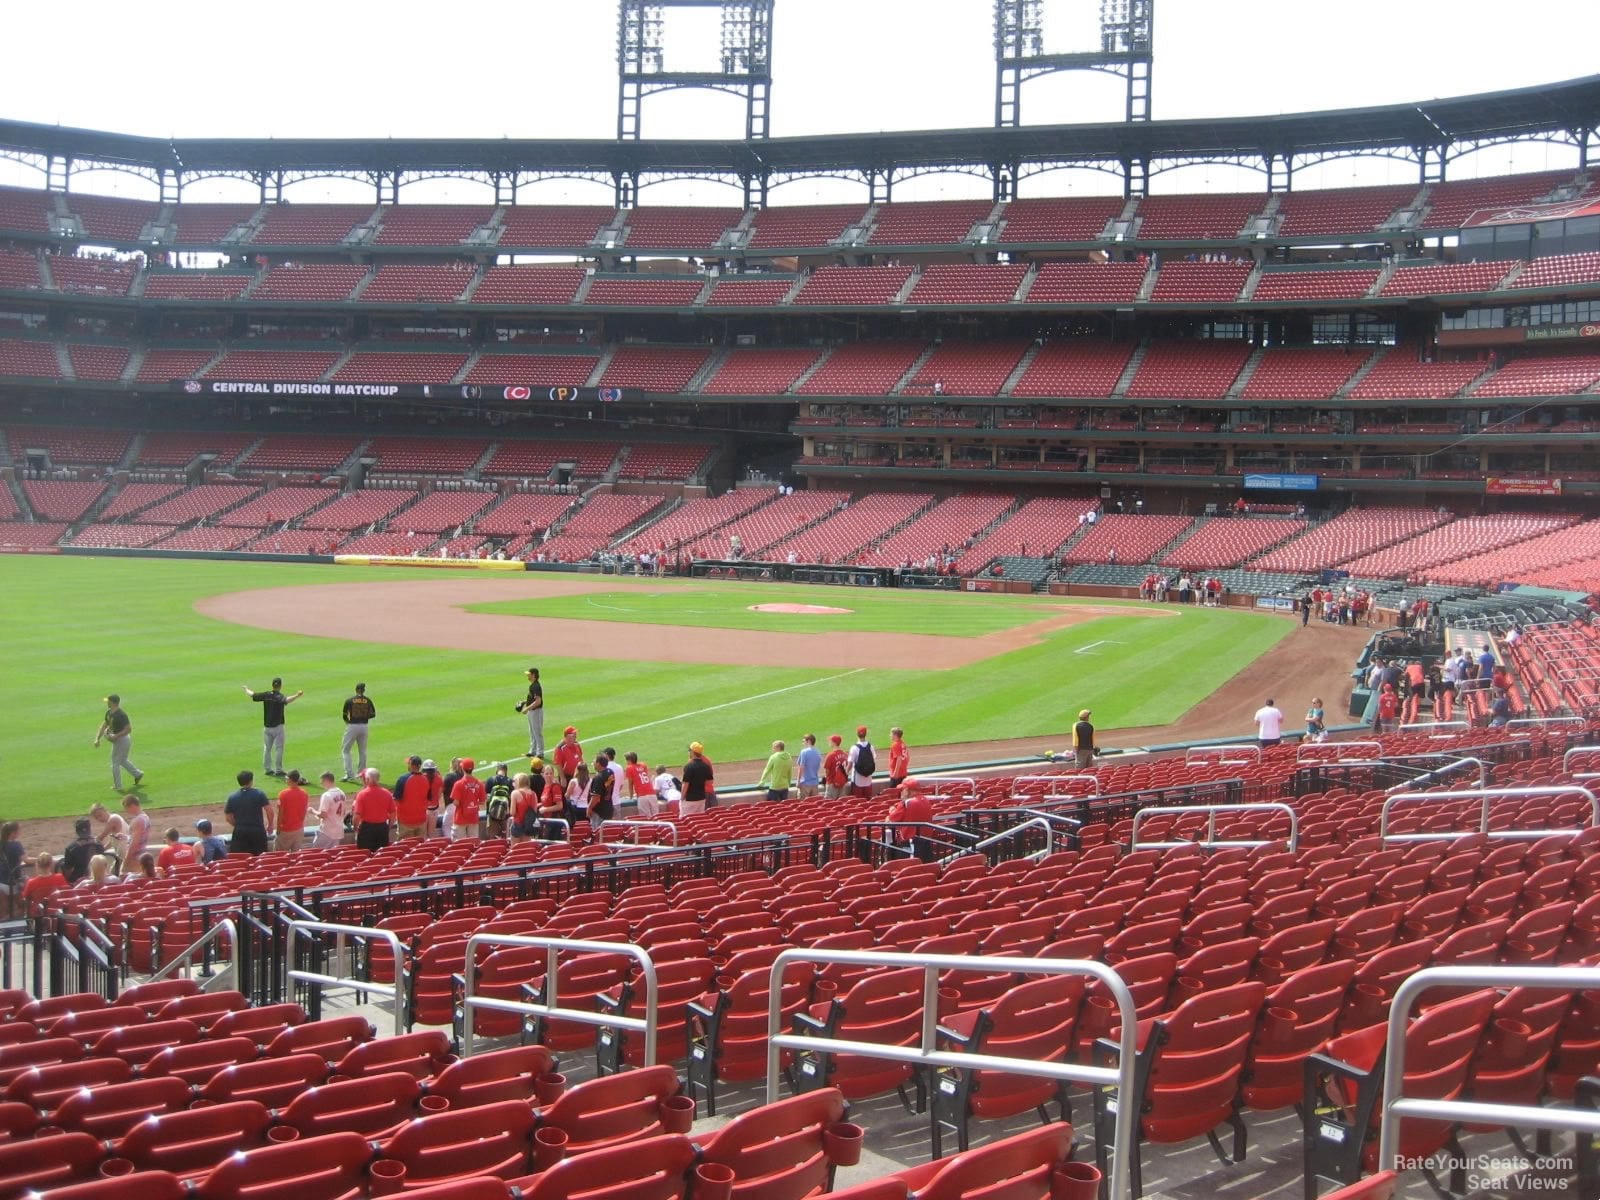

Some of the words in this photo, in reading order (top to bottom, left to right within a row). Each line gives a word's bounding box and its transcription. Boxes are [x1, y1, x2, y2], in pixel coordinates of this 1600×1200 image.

[212, 382, 270, 393] CENTRAL
[273, 383, 331, 394] DIVISION
[334, 384, 399, 396] MATCHUP
[558, 387, 568, 400] P
[638, 771, 650, 785] 16
[335, 802, 343, 817] 4
